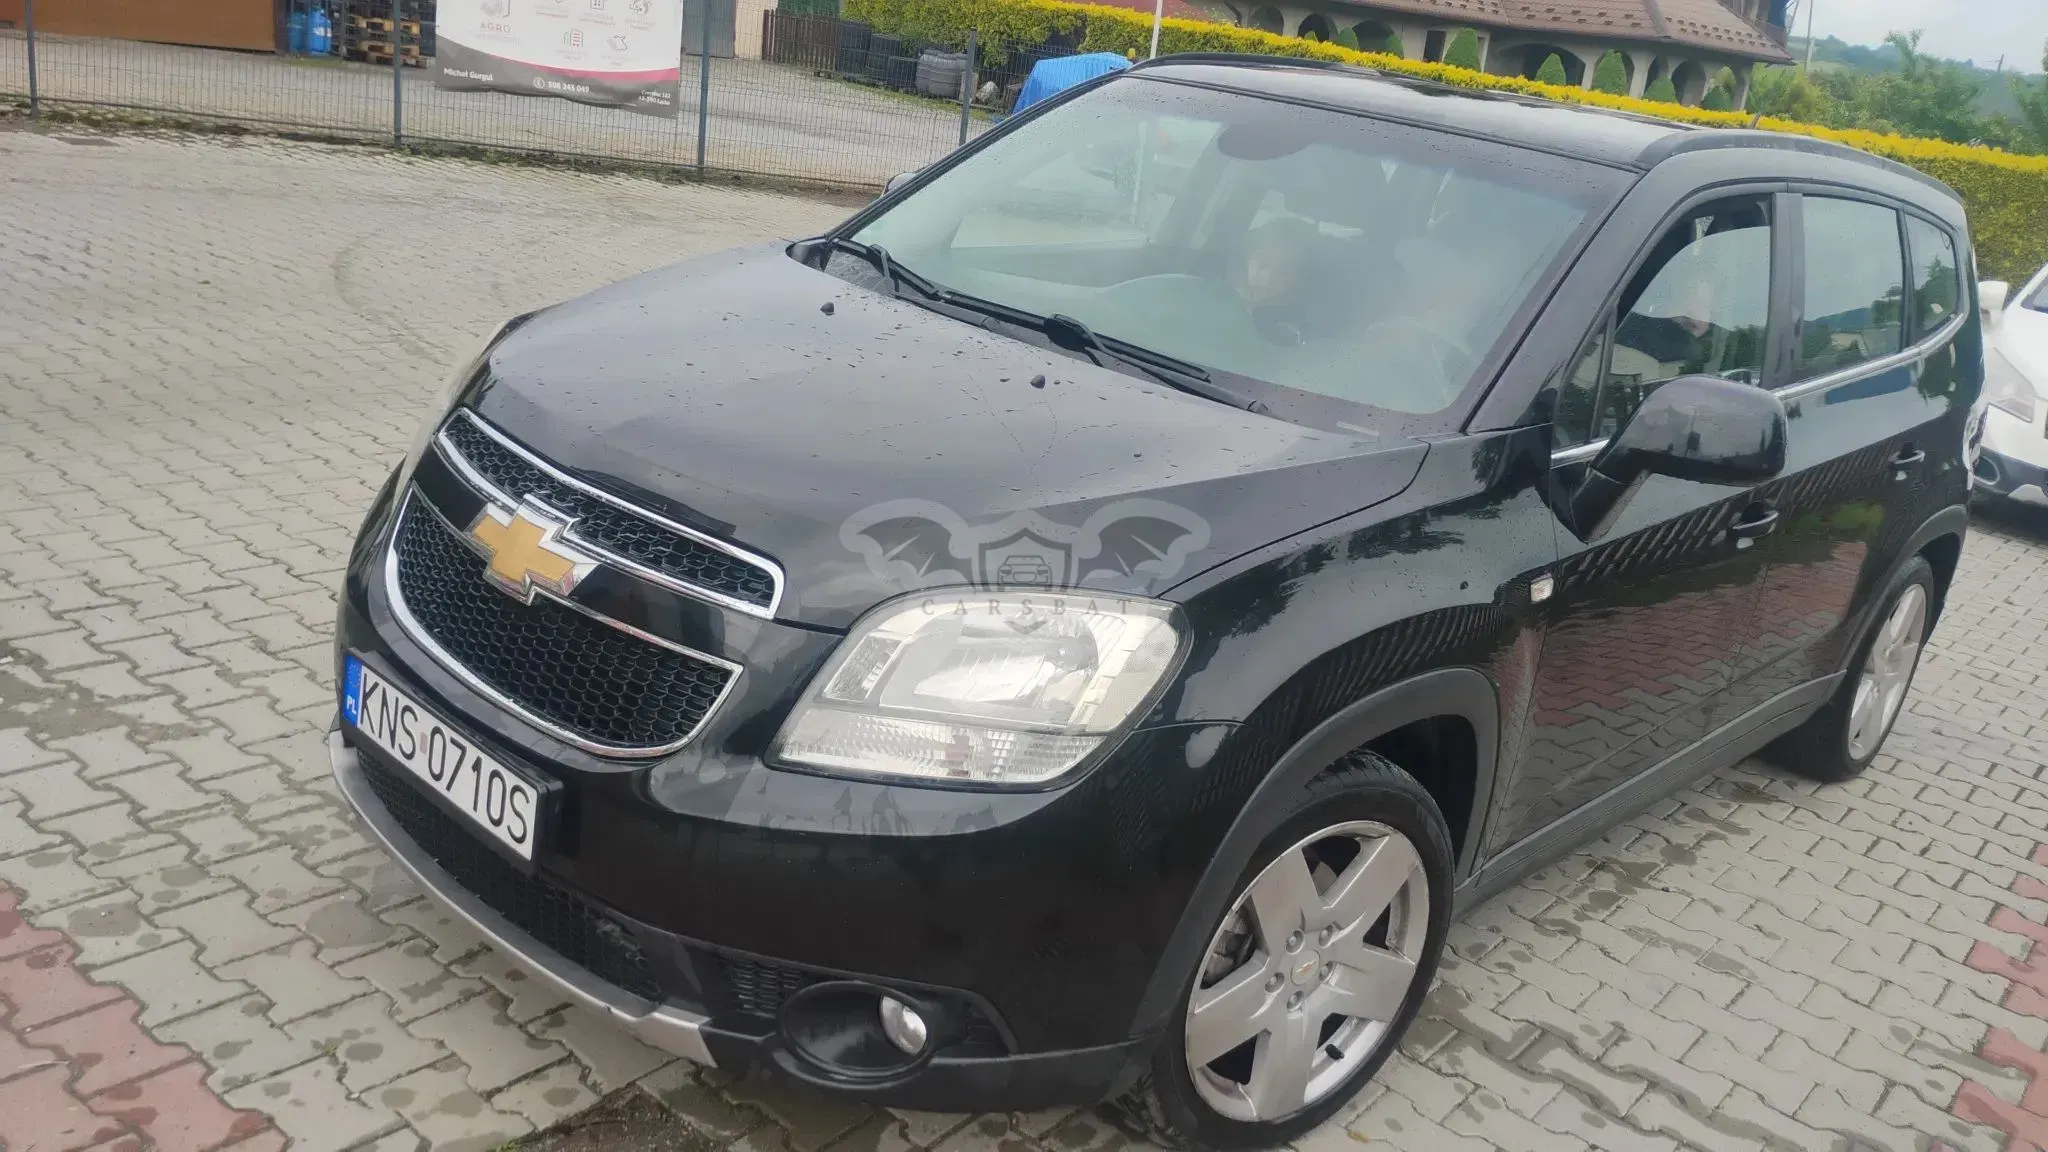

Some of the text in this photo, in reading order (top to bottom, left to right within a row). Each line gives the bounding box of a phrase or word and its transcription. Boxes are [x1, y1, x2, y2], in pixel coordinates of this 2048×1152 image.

[480, 22, 511, 33] AGRO
[346, 695, 357, 714] PL
[360, 673, 530, 844] KNS 0710S
